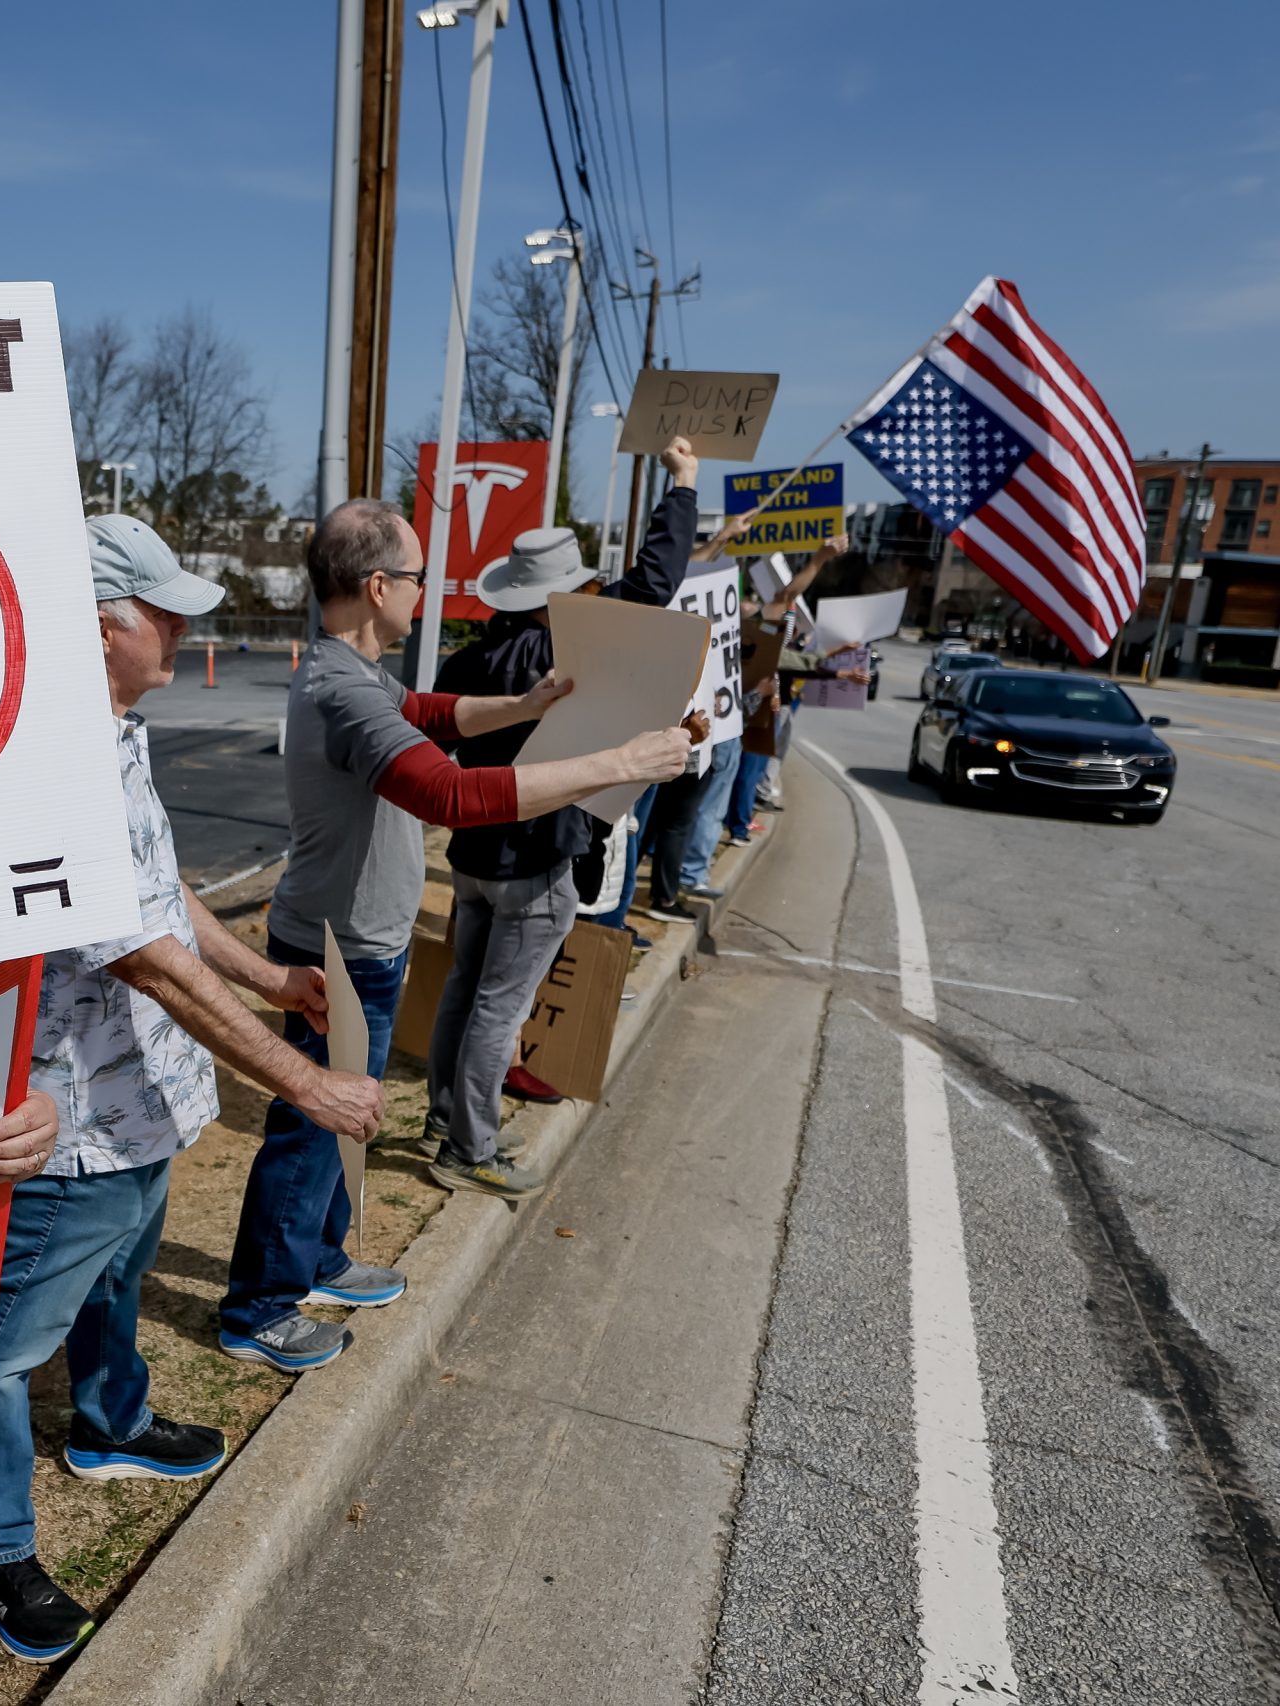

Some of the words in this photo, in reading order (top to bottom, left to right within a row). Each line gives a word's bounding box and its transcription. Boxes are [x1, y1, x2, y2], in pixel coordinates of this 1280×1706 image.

[658, 380, 769, 412] DUMP
[656, 414, 756, 438] MUSK
[732, 475, 762, 491] WE
